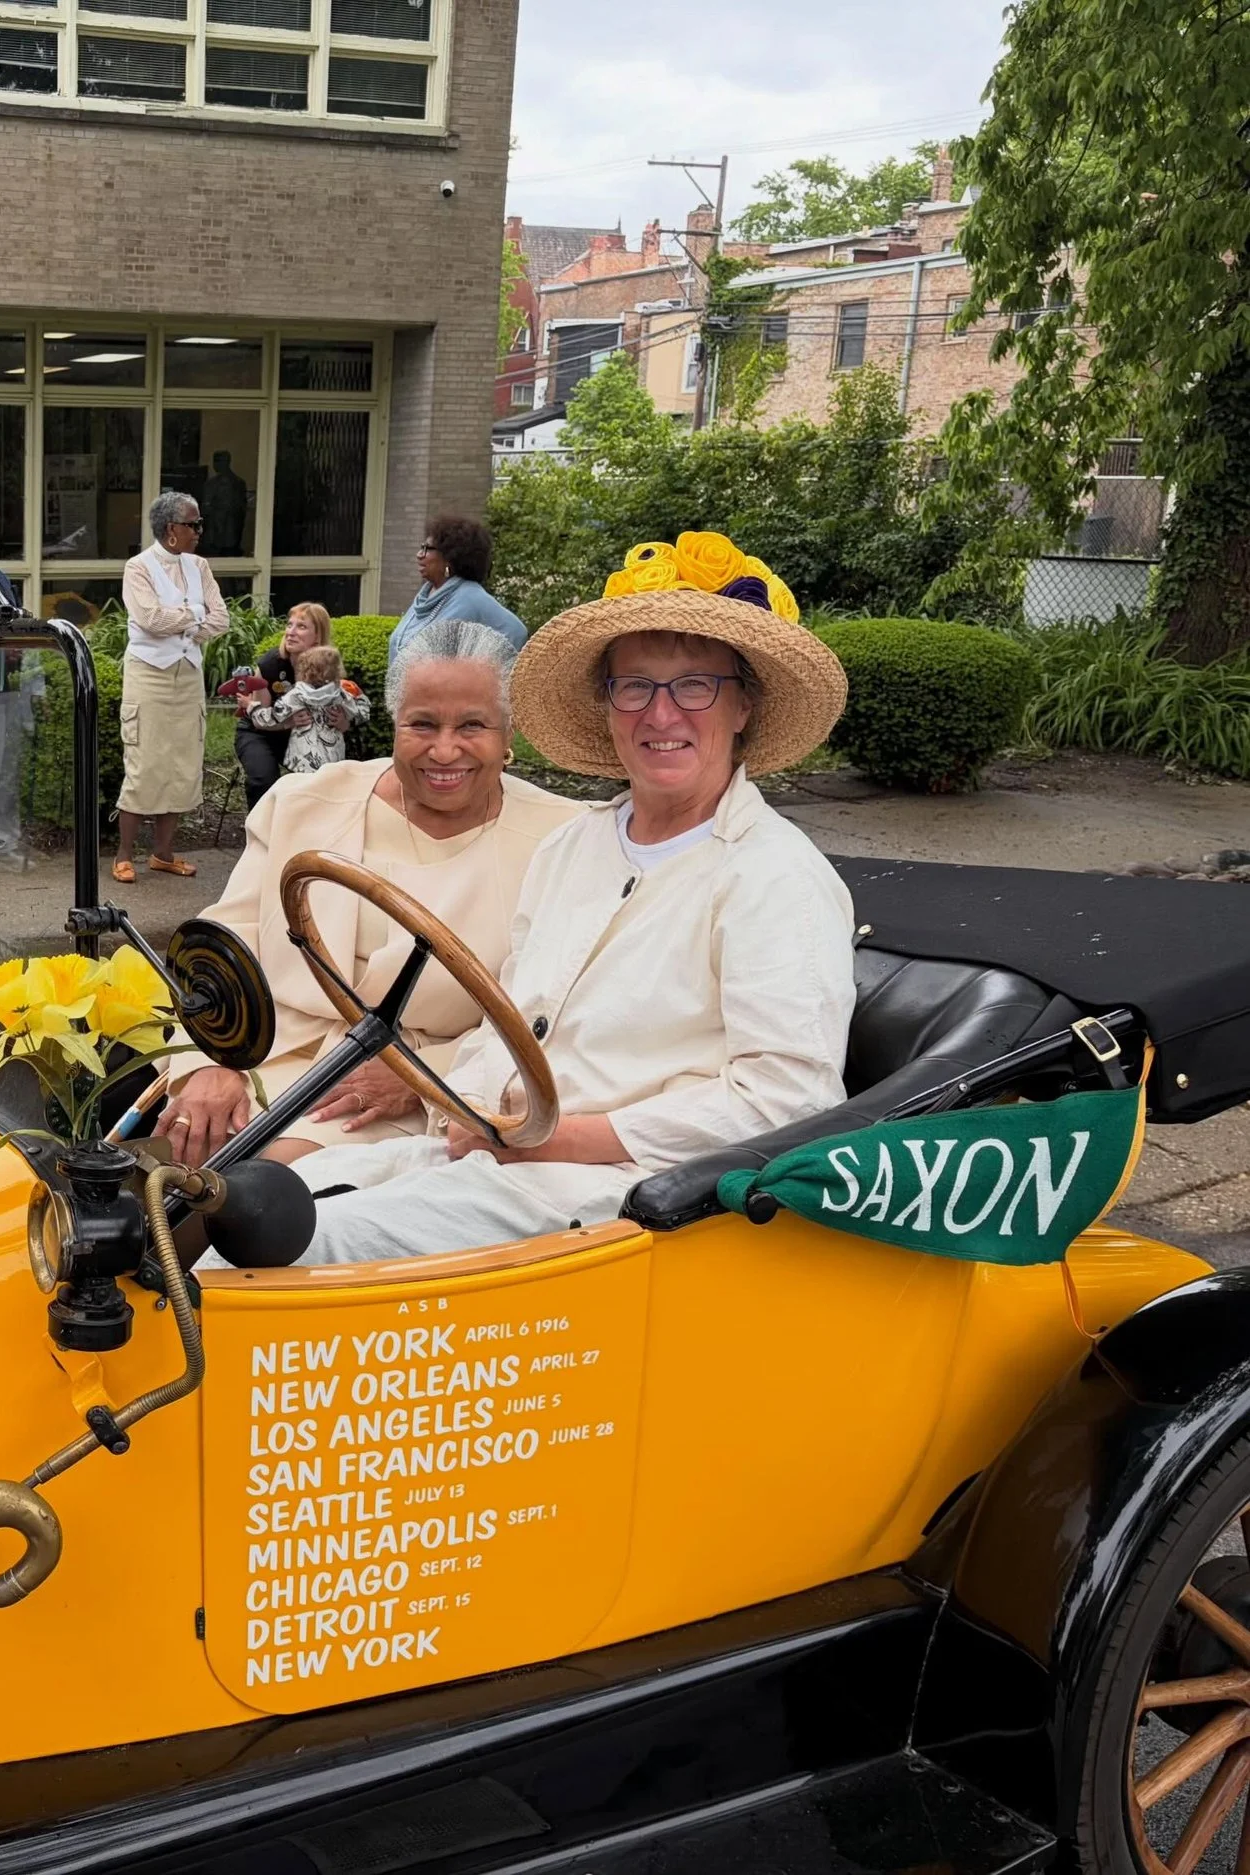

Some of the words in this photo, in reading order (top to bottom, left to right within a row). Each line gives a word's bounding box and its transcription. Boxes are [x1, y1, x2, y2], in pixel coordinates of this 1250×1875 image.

[821, 1131, 1090, 1236] SAXON
[251, 1335, 341, 1377] NEW
[352, 1323, 456, 1366] YORK
[464, 1323, 514, 1343] APRIL
[519, 1322, 529, 1336] 6
[535, 1316, 569, 1333] 1916
[251, 1375, 340, 1417] NEW
[351, 1355, 520, 1406] ORLEANS
[529, 1353, 577, 1374] APRIL
[581, 1350, 600, 1364] 27
[251, 1419, 317, 1457] LOS
[329, 1397, 494, 1449] ANGELES
[502, 1396, 546, 1416] JUNE
[551, 1393, 562, 1407] 5
[246, 1457, 322, 1496] SAN
[338, 1428, 539, 1486] FRANCISCO
[547, 1425, 590, 1446] JUNE
[595, 1422, 614, 1436] 28
[245, 1488, 393, 1535] SEATTLE
[404, 1486, 444, 1505] JULY
[449, 1484, 465, 1498] 13
[248, 1509, 498, 1573] MINNEAPOLIS
[506, 1506, 548, 1525] SEPT.
[551, 1504, 558, 1517] 1
[245, 1561, 409, 1612] CHICAGO
[419, 1557, 461, 1577] SEPT.
[465, 1555, 482, 1569] 12
[247, 1597, 399, 1650] DETROIT
[406, 1595, 449, 1615] SEPT.
[454, 1593, 471, 1607] 15
[246, 1645, 331, 1686] NEW
[342, 1626, 441, 1671] YORK
